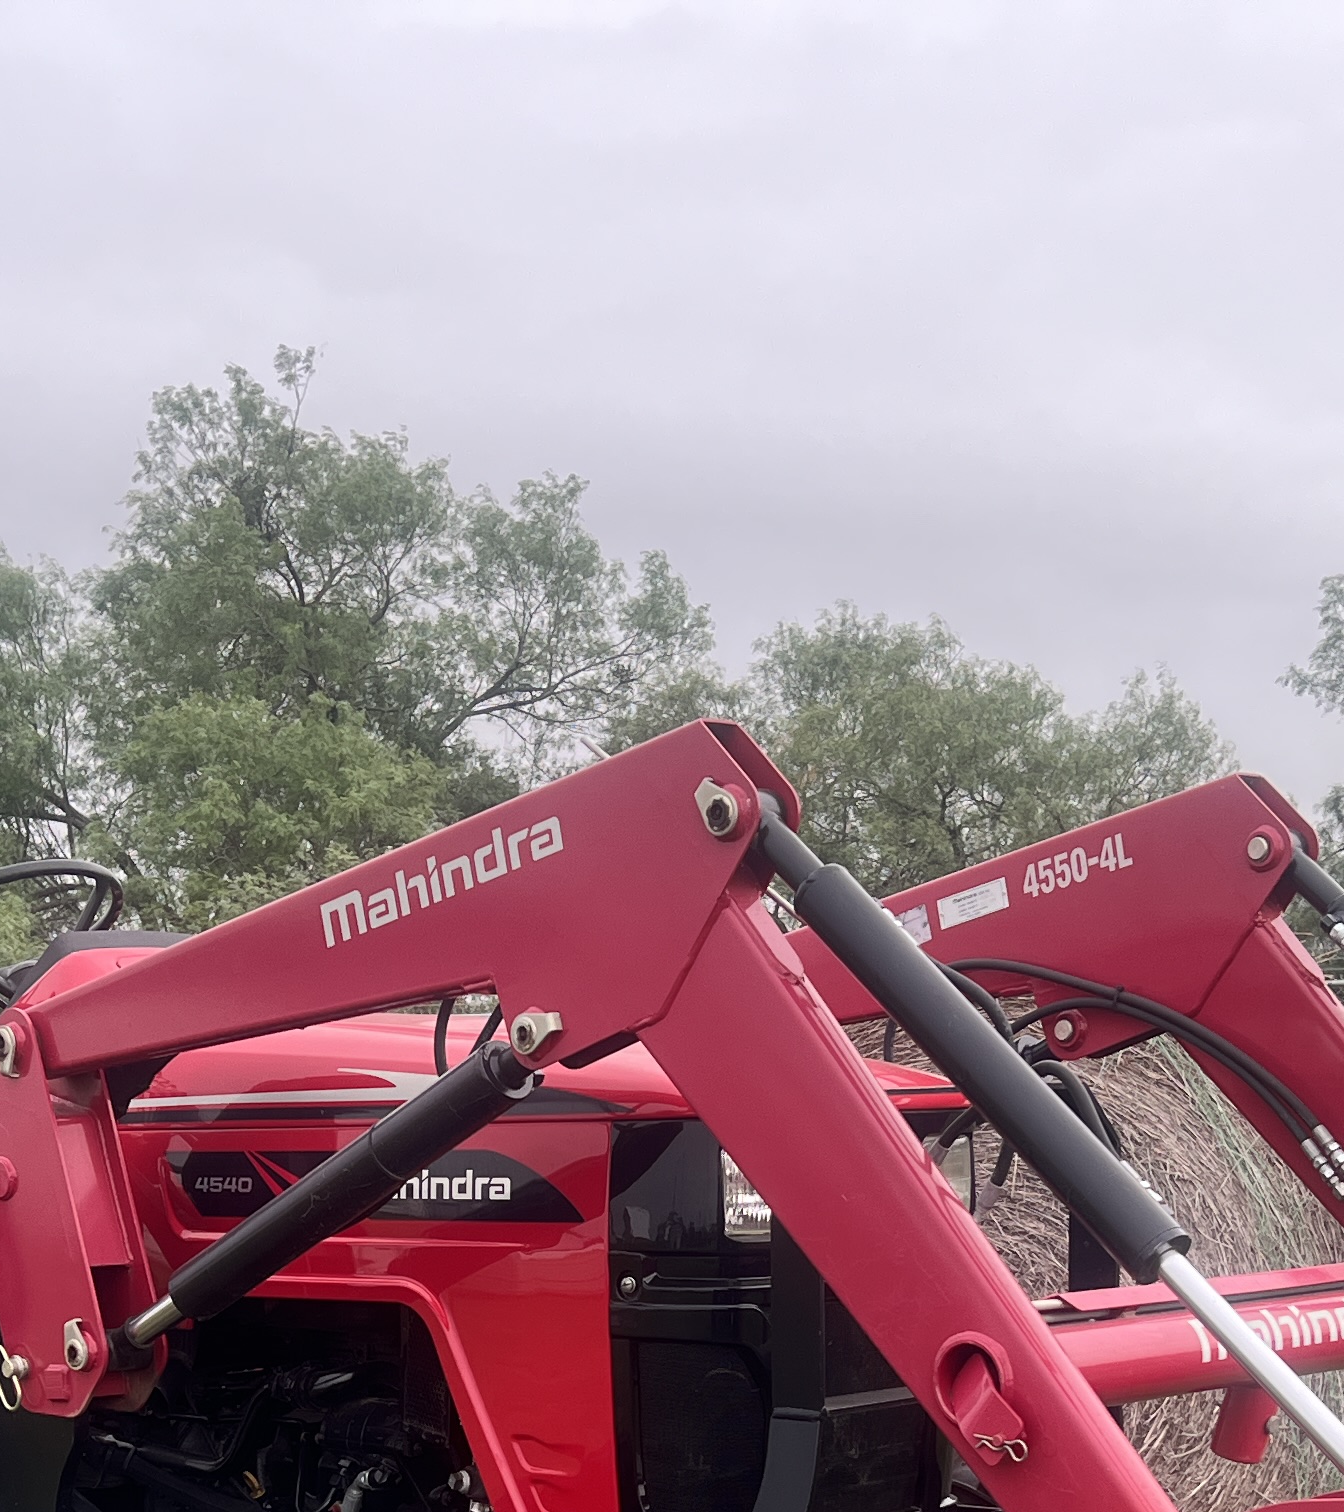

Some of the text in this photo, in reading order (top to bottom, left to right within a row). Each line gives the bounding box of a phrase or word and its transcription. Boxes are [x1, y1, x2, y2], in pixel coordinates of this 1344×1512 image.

[319, 816, 564, 949] Mahindra
[1023, 833, 1133, 897] 4550-4L
[194, 1177, 253, 1193] 4540
[392, 1169, 511, 1200] hindra
